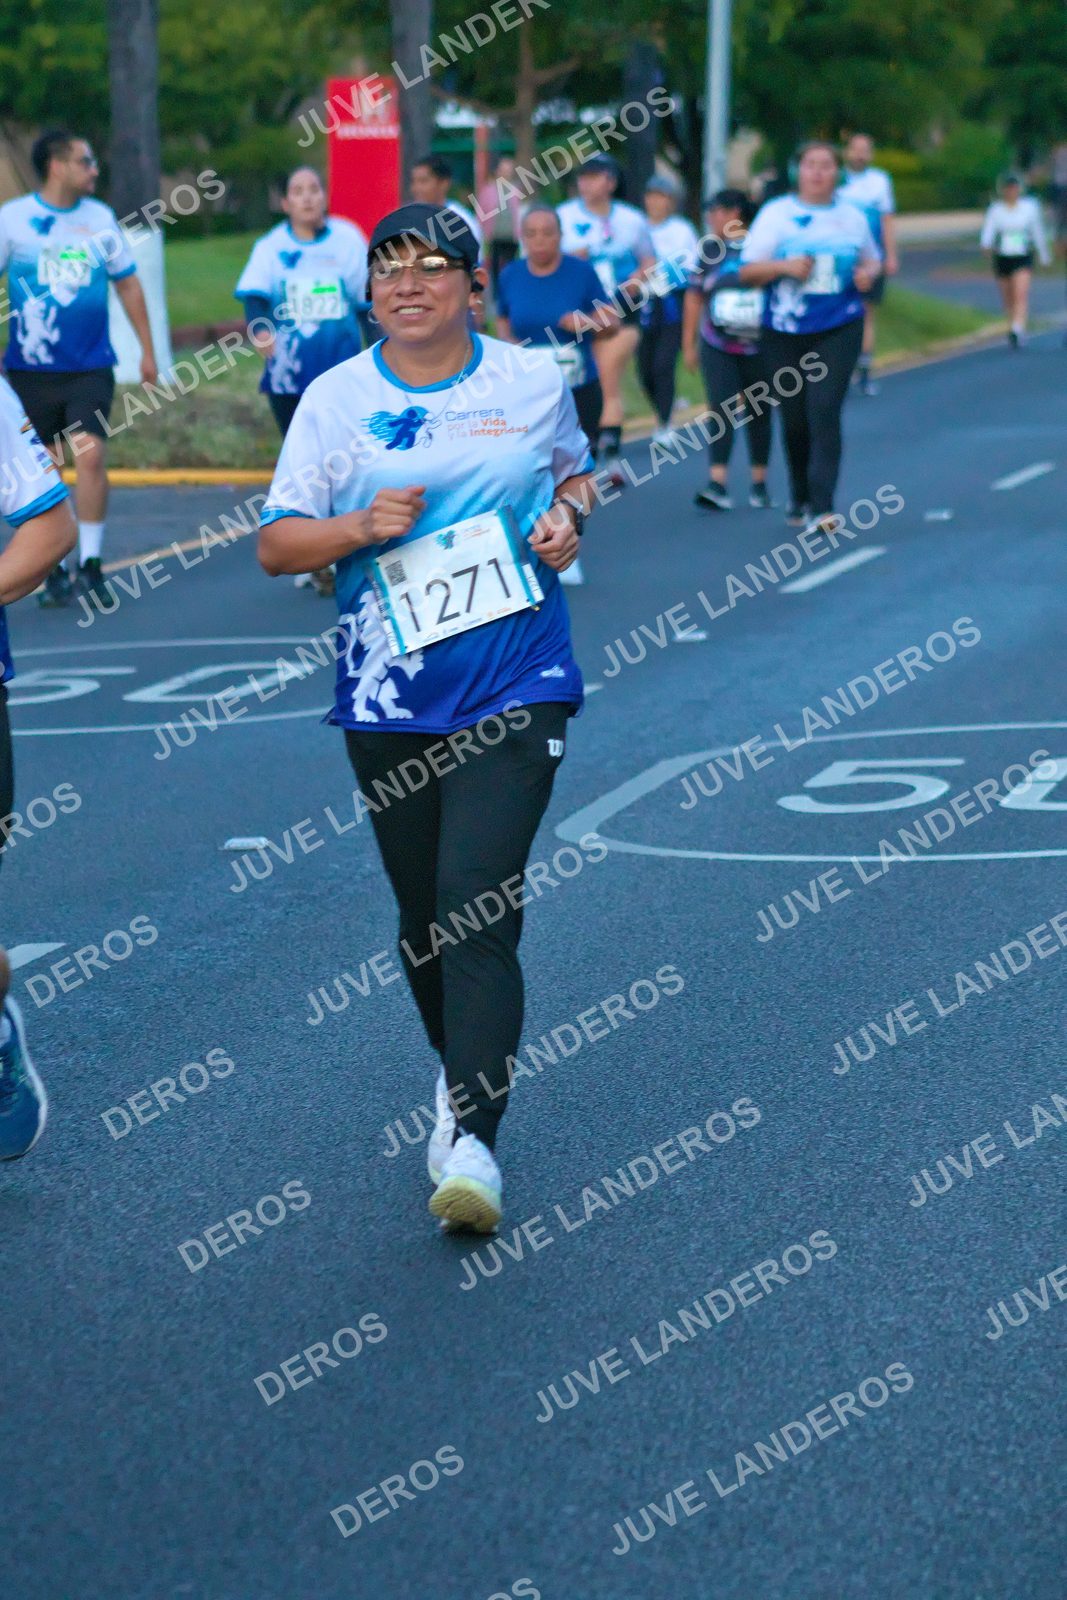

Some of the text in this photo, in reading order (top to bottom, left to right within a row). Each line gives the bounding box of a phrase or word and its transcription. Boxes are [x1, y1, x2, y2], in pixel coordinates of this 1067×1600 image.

[445, 408, 504, 421] Carrera
[481, 418, 506, 427] Vida
[400, 558, 511, 632] 1271
